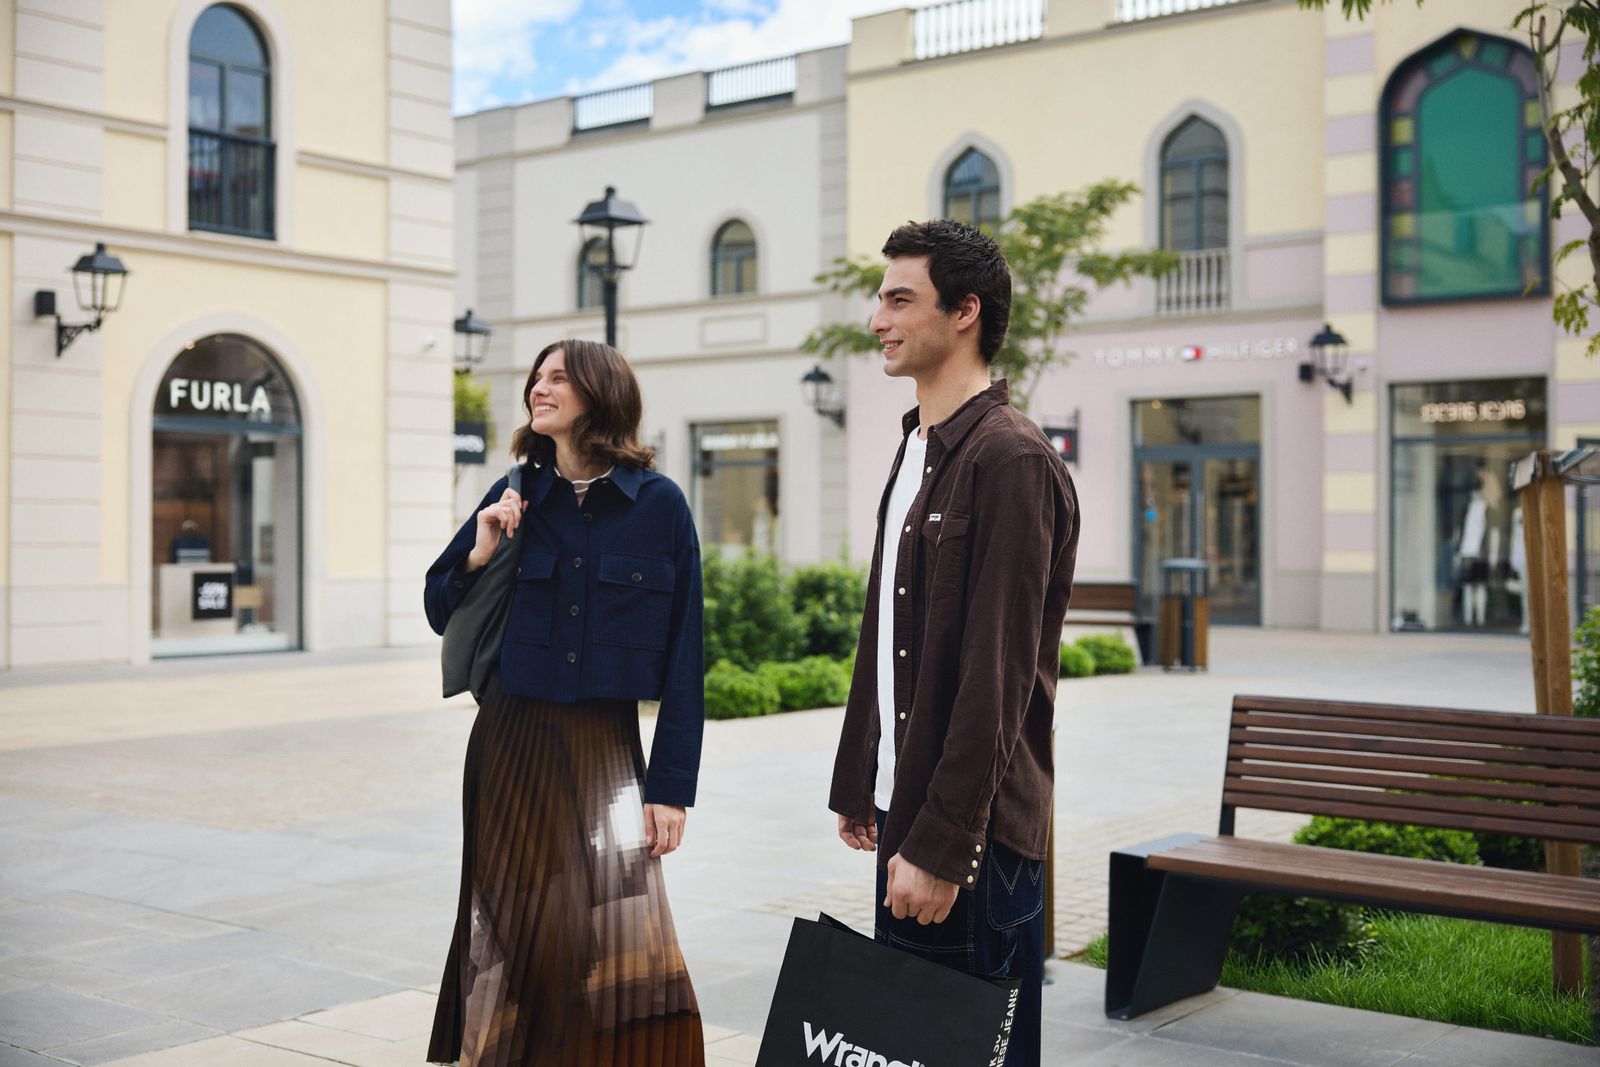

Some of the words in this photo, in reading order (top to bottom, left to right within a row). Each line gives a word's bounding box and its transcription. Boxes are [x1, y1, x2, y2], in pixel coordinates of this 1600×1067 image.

[1095, 346, 1177, 368] TOMMY
[1206, 337, 1298, 361] HILFIGER
[170, 378, 272, 415] FURLA
[1004, 988, 1019, 1034] JEANS
